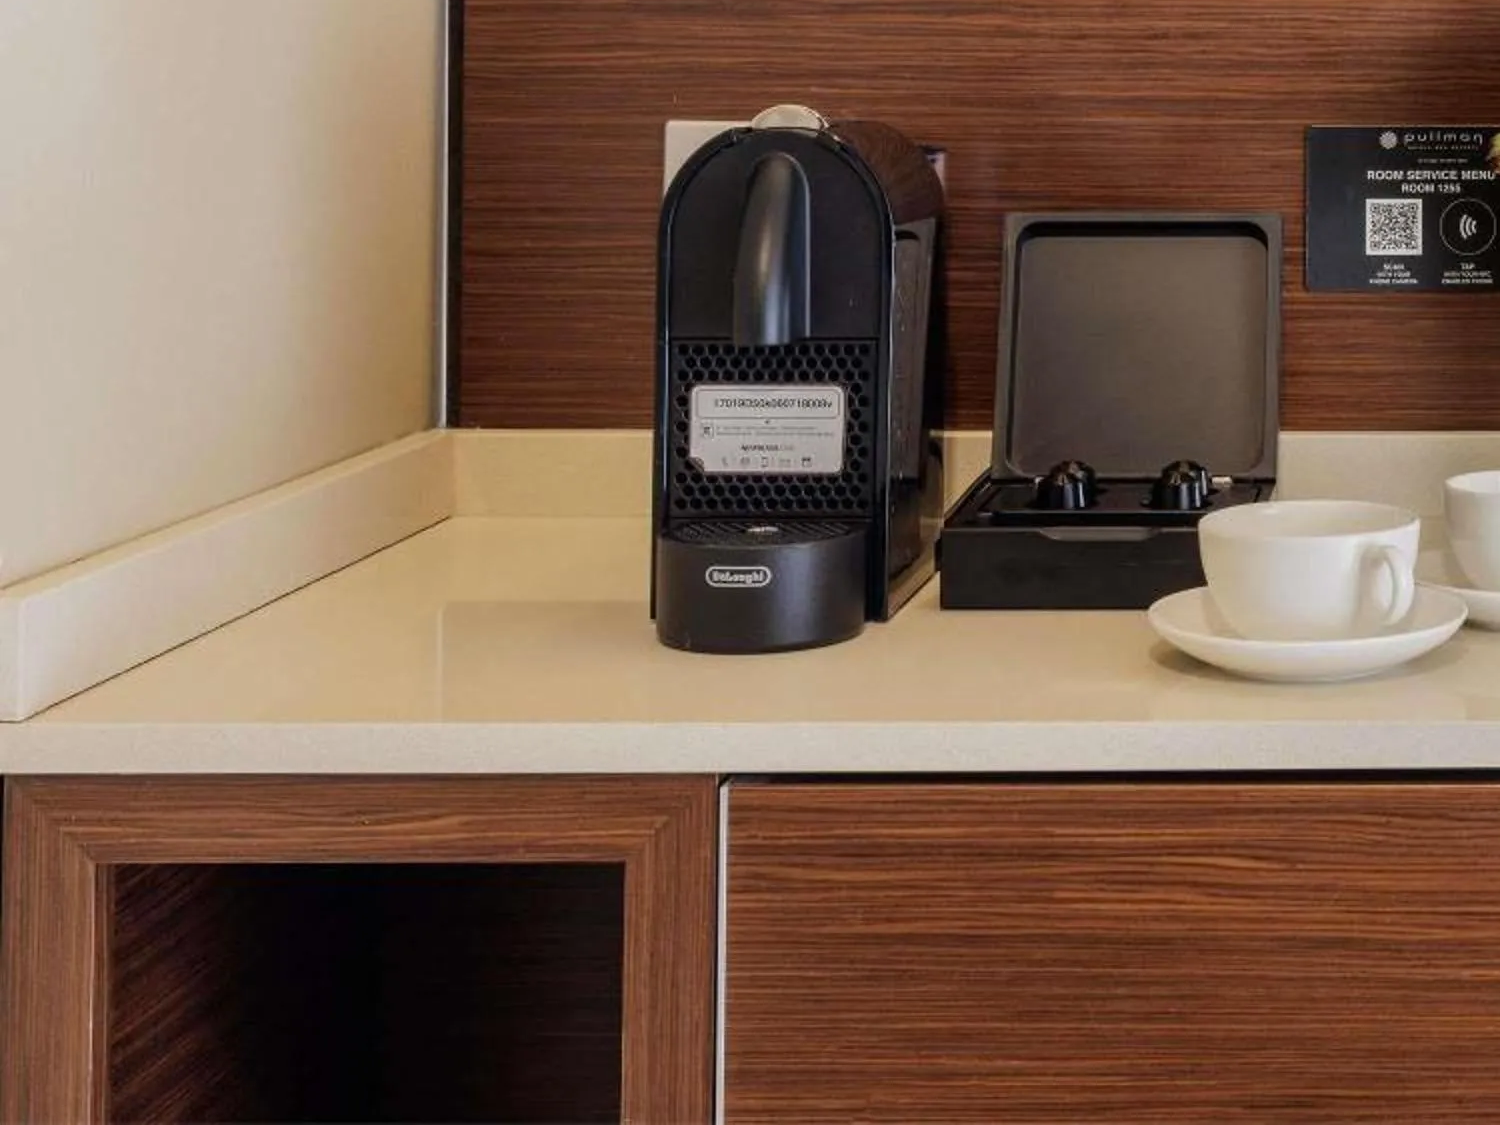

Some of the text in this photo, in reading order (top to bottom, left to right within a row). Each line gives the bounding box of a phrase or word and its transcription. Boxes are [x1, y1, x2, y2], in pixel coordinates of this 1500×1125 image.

[1367, 170, 1404, 180] ROOM
[1406, 170, 1458, 180] SERVICE
[1401, 183, 1435, 193] ROOM
